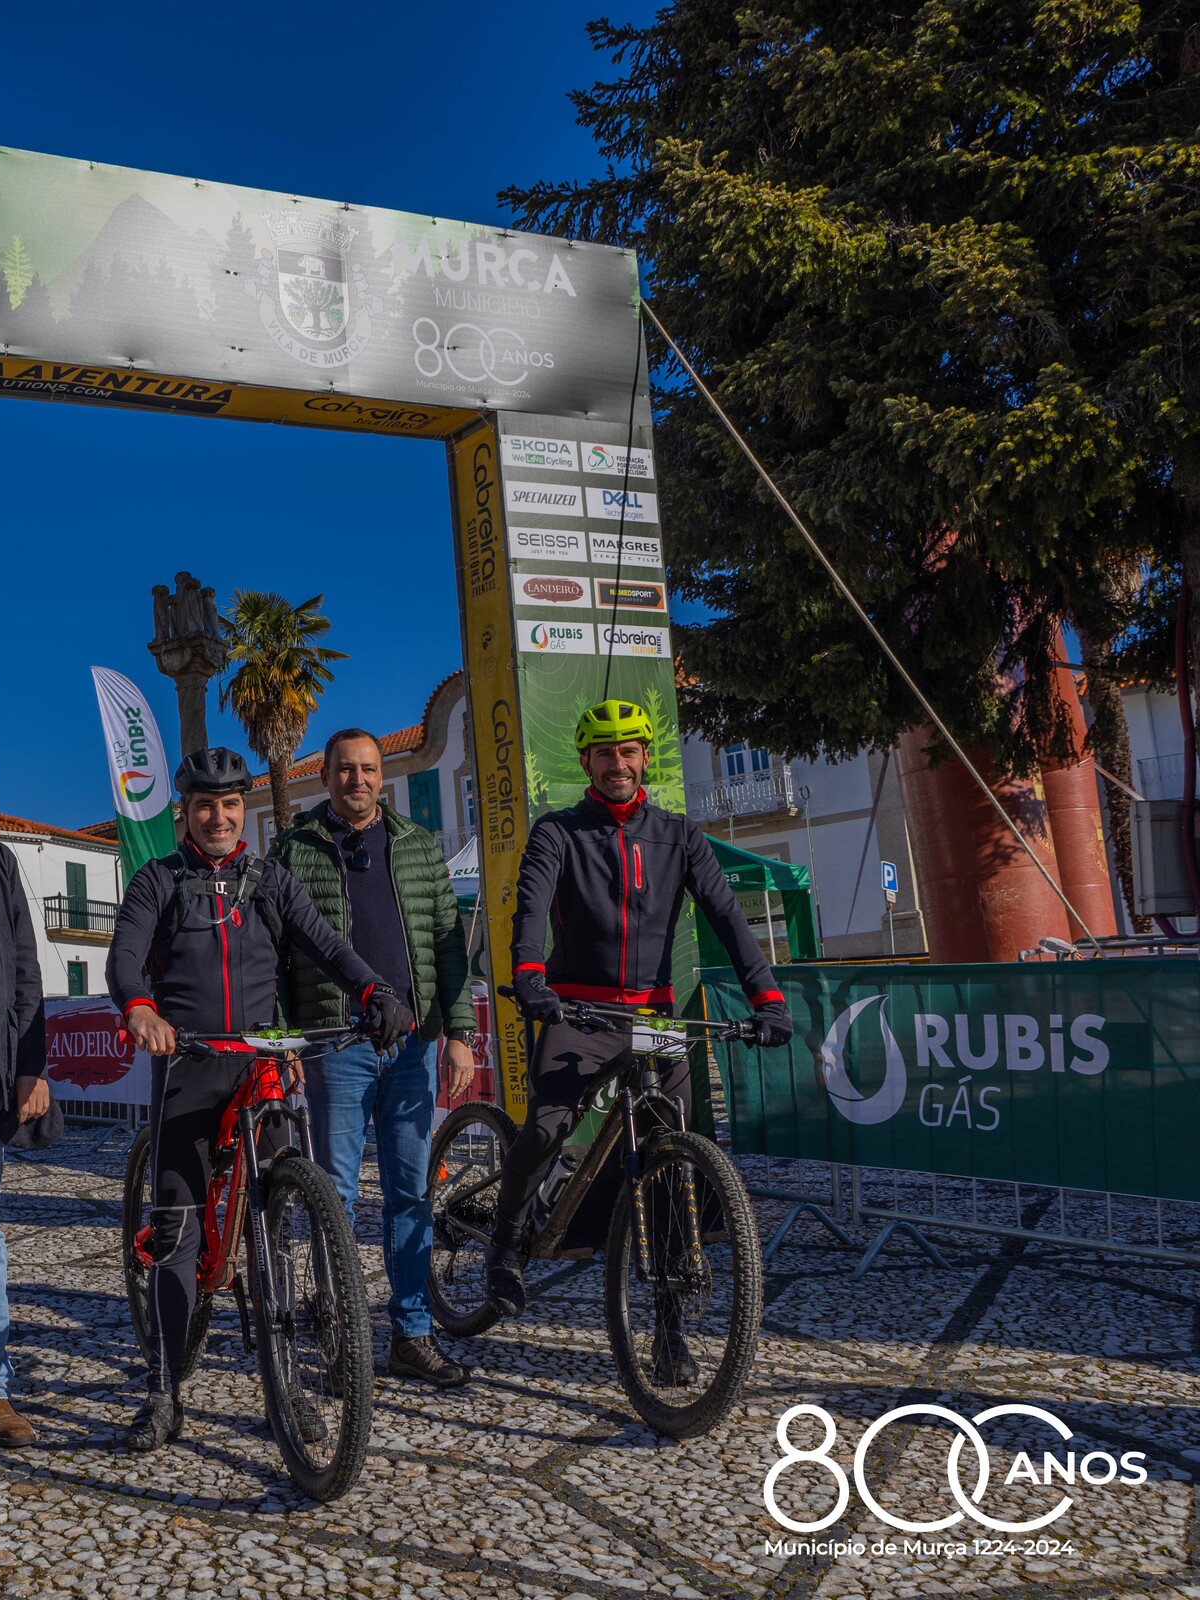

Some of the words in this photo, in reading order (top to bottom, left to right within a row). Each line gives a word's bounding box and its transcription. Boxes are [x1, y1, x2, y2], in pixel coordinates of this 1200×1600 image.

[268, 319, 294, 352] VILA
[299, 349, 318, 363] DE
[501, 349, 555, 368] ANOS
[15, 364, 233, 403] AVENTURA
[456, 383, 467, 392] de
[304, 397, 429, 422] Cabreira
[512, 454, 524, 462] We
[546, 457, 572, 467] Cycling
[511, 491, 576, 506] SPECIALIZED
[473, 443, 498, 580] Cabreira
[518, 533, 578, 549] SEISSA
[593, 539, 658, 553] MARGRES
[467, 518, 480, 586] SOLUTIONS
[594, 553, 632, 561] CERAIC
[472, 579, 496, 598] EVENTOS
[527, 584, 579, 595] LANDEIRO
[550, 628, 583, 640] RUBiS
[604, 628, 657, 646] Cabreira
[550, 640, 565, 650] GÁS
[632, 646, 657, 655] SOLUTIONS
[492, 699, 518, 840] Cabreira
[486, 773, 499, 841] SOLUTIONS
[884, 865, 893, 887] P
[914, 1013, 1110, 1075] RUBiS
[505, 1023, 520, 1091] SOLUTIONS
[919, 1076, 1001, 1131] GÁS
